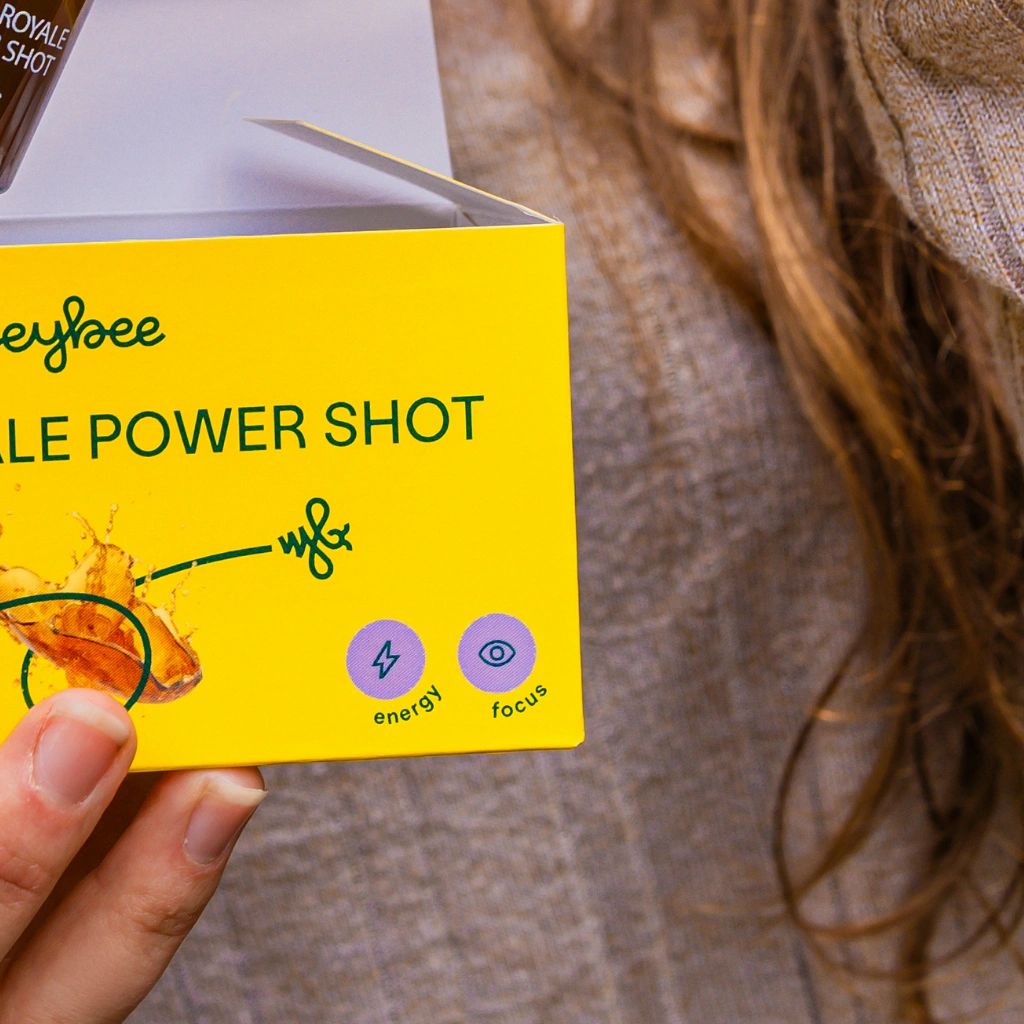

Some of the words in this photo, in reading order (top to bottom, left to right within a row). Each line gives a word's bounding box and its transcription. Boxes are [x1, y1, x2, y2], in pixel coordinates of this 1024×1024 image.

[1, 40, 57, 77] SHOT
[89, 404, 307, 460] POWER
[324, 394, 485, 448] SHOT
[373, 685, 442, 725] energy
[491, 684, 548, 719] focus
